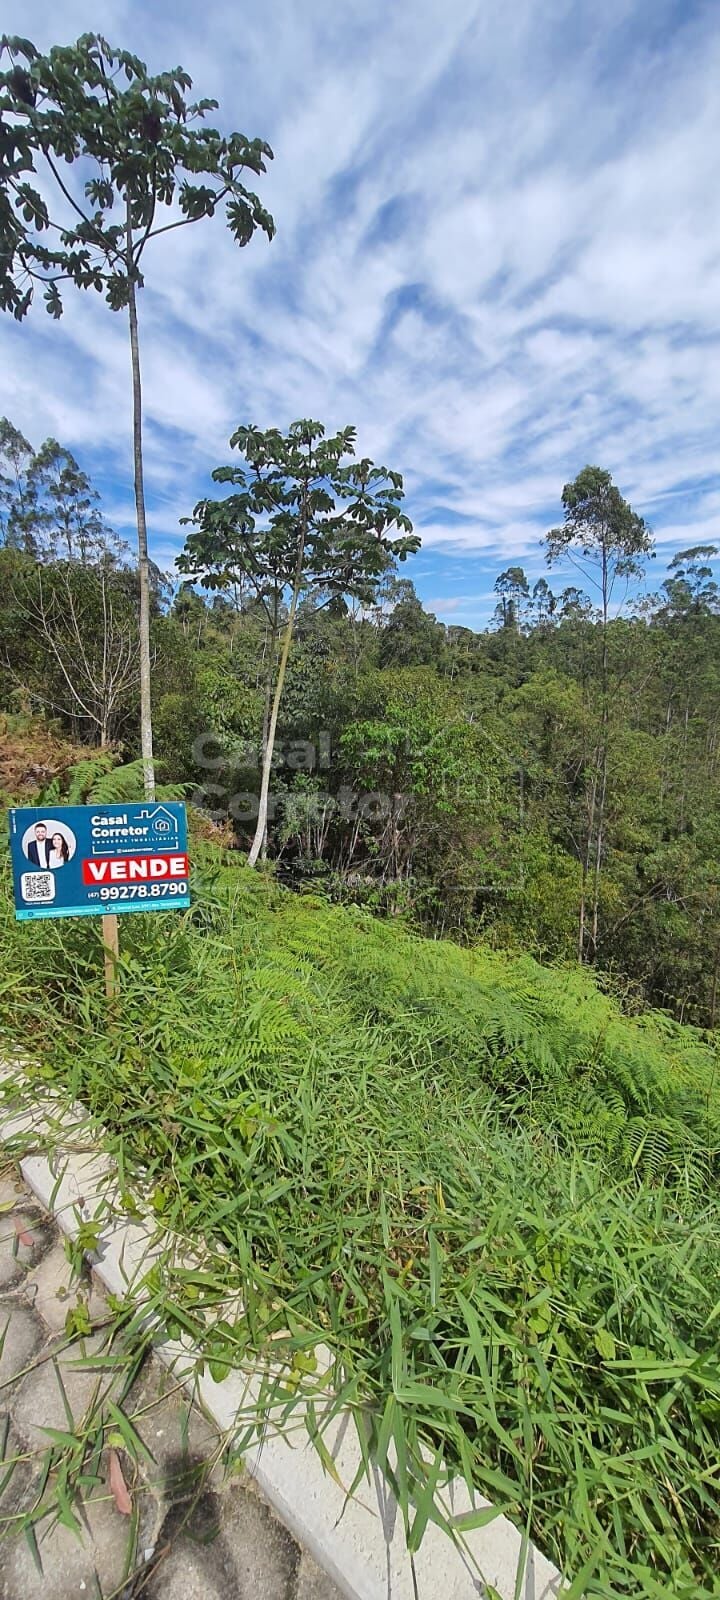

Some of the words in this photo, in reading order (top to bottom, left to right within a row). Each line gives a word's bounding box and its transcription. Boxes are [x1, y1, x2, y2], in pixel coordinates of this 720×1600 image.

[91, 814, 128, 826] Casal
[91, 826, 149, 838] Corretor
[88, 857, 186, 881] VENDE
[100, 882, 188, 900] 99278.8790
